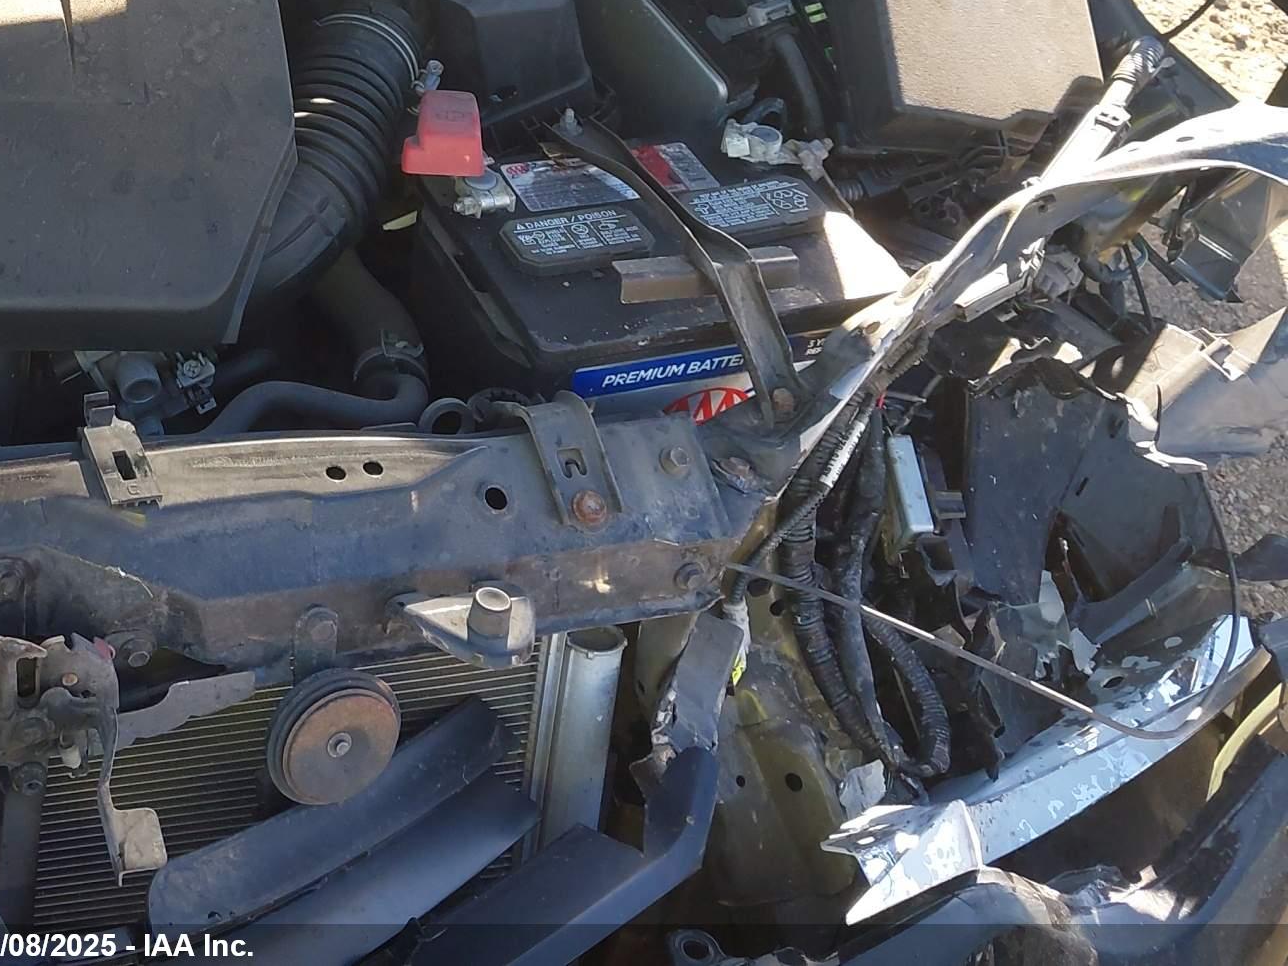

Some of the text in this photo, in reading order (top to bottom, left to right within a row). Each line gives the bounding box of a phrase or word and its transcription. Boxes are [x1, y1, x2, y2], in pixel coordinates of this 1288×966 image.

[525, 216, 569, 230] DANGER
[577, 209, 617, 222] POISON
[601, 363, 687, 388] PREMIUM
